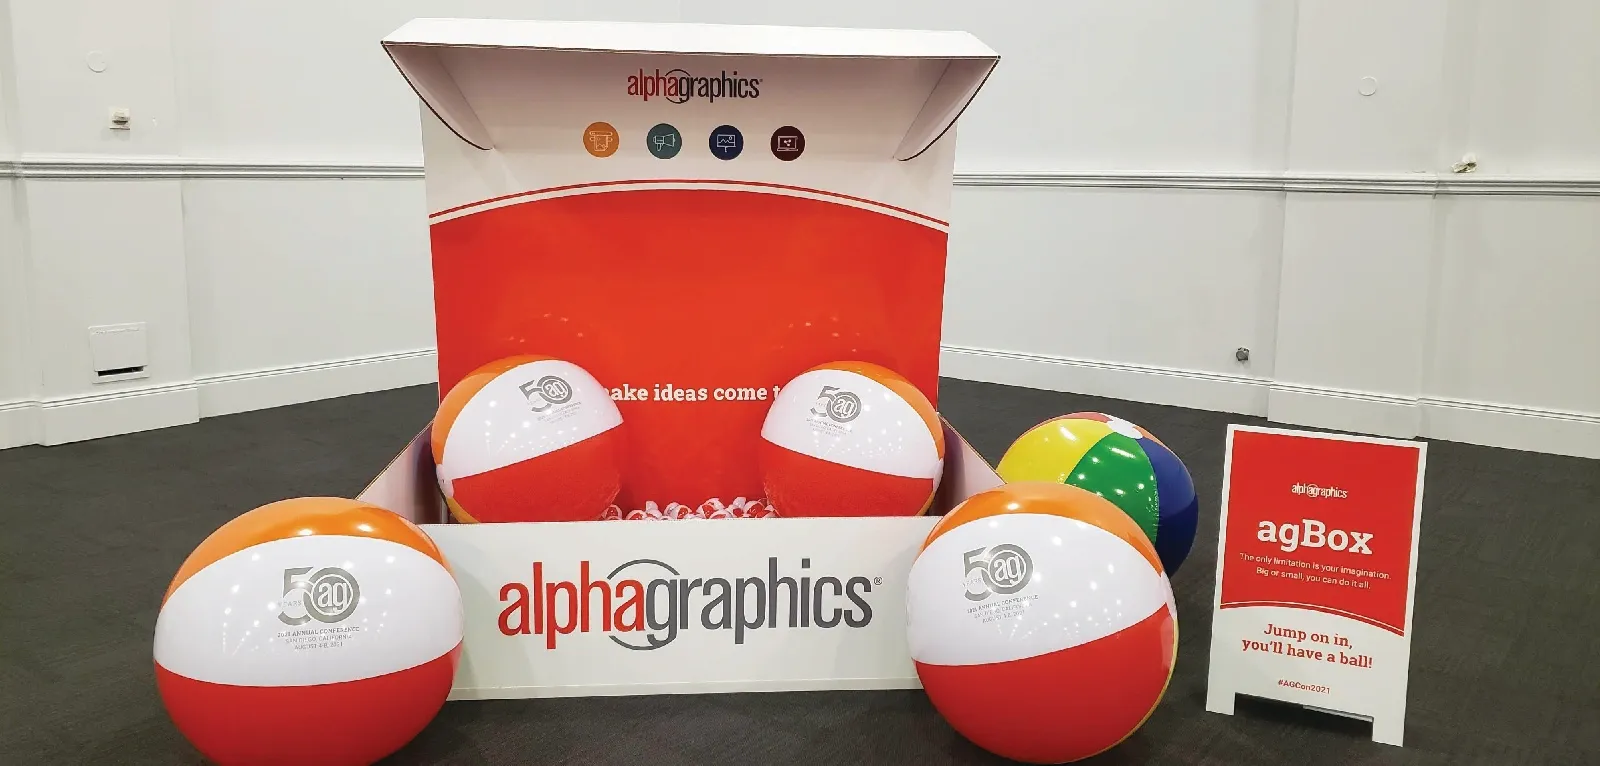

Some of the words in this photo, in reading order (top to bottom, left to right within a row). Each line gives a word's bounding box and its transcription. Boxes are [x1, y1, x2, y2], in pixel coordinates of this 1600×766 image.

[627, 69, 763, 104] alphagraphics
[605, 383, 649, 401] ake
[653, 384, 708, 401] ideas
[713, 387, 767, 401] come
[1291, 482, 1348, 499] alphagraphics
[1257, 519, 1374, 555] agBox
[994, 555, 1022, 586] ag
[1240, 553, 1254, 561] The
[1256, 556, 1272, 565] only
[1273, 557, 1311, 569] limitation
[1312, 562, 1320, 570] is
[1320, 564, 1339, 573] your
[1341, 566, 1392, 580] imagination.
[1256, 566, 1269, 577] Big
[1281, 571, 1305, 581] small,
[1306, 575, 1321, 583] you
[1339, 578, 1350, 586] do
[1358, 581, 1371, 589] all.
[317, 582, 348, 613] ag
[292, 629, 318, 637] ANNUAL
[320, 626, 360, 634] CONFERENCE
[1264, 623, 1307, 642] Jump
[1311, 632, 1329, 644] on
[1334, 633, 1353, 649] in,
[1287, 644, 1323, 660] have
[1327, 653, 1336, 662] a
[1340, 651, 1373, 668] ball!
[1278, 679, 1331, 694] #AGCon2021
